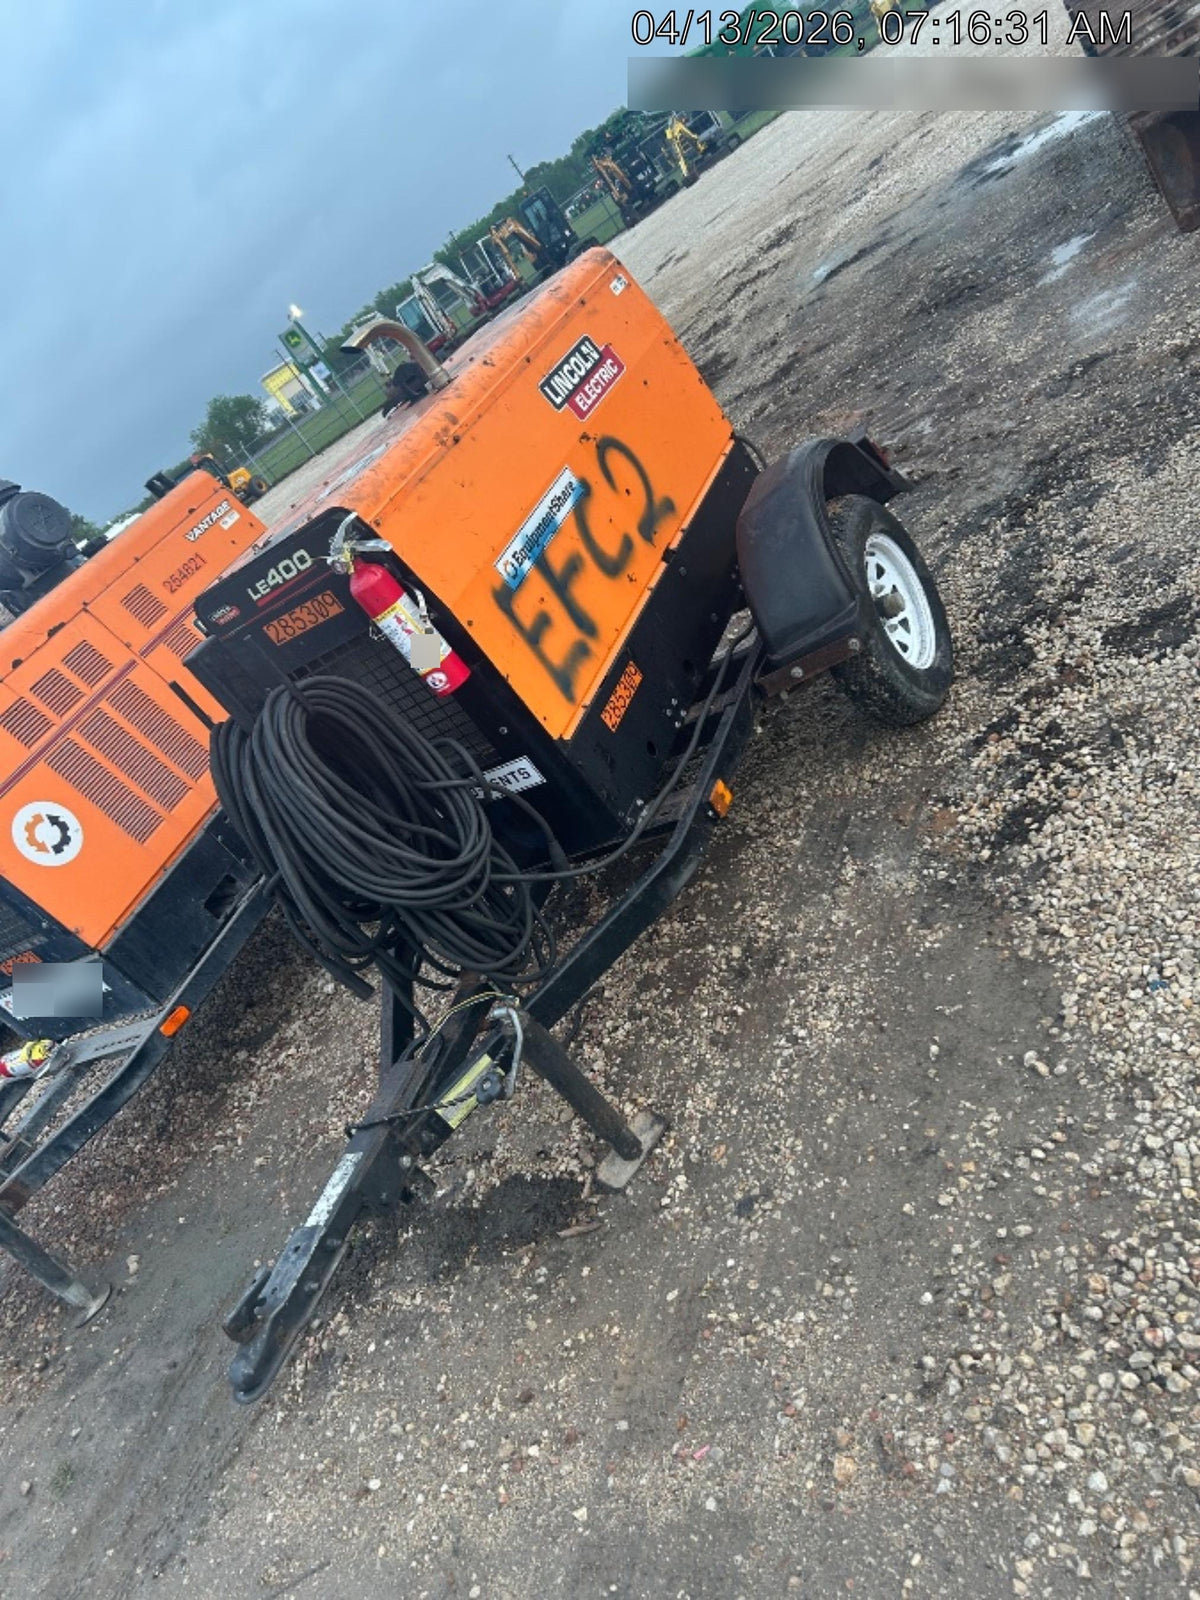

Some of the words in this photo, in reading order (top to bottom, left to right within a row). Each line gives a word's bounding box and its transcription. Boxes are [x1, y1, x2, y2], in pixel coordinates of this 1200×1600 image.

[545, 340, 601, 405] LINCOLN
[574, 358, 619, 412] ELECTRIC
[185, 499, 231, 542] VANTAGE
[511, 480, 577, 568] EquipmentShare
[163, 552, 208, 594] 254821
[247, 549, 313, 600] LE400
[266, 592, 344, 644] 285309
